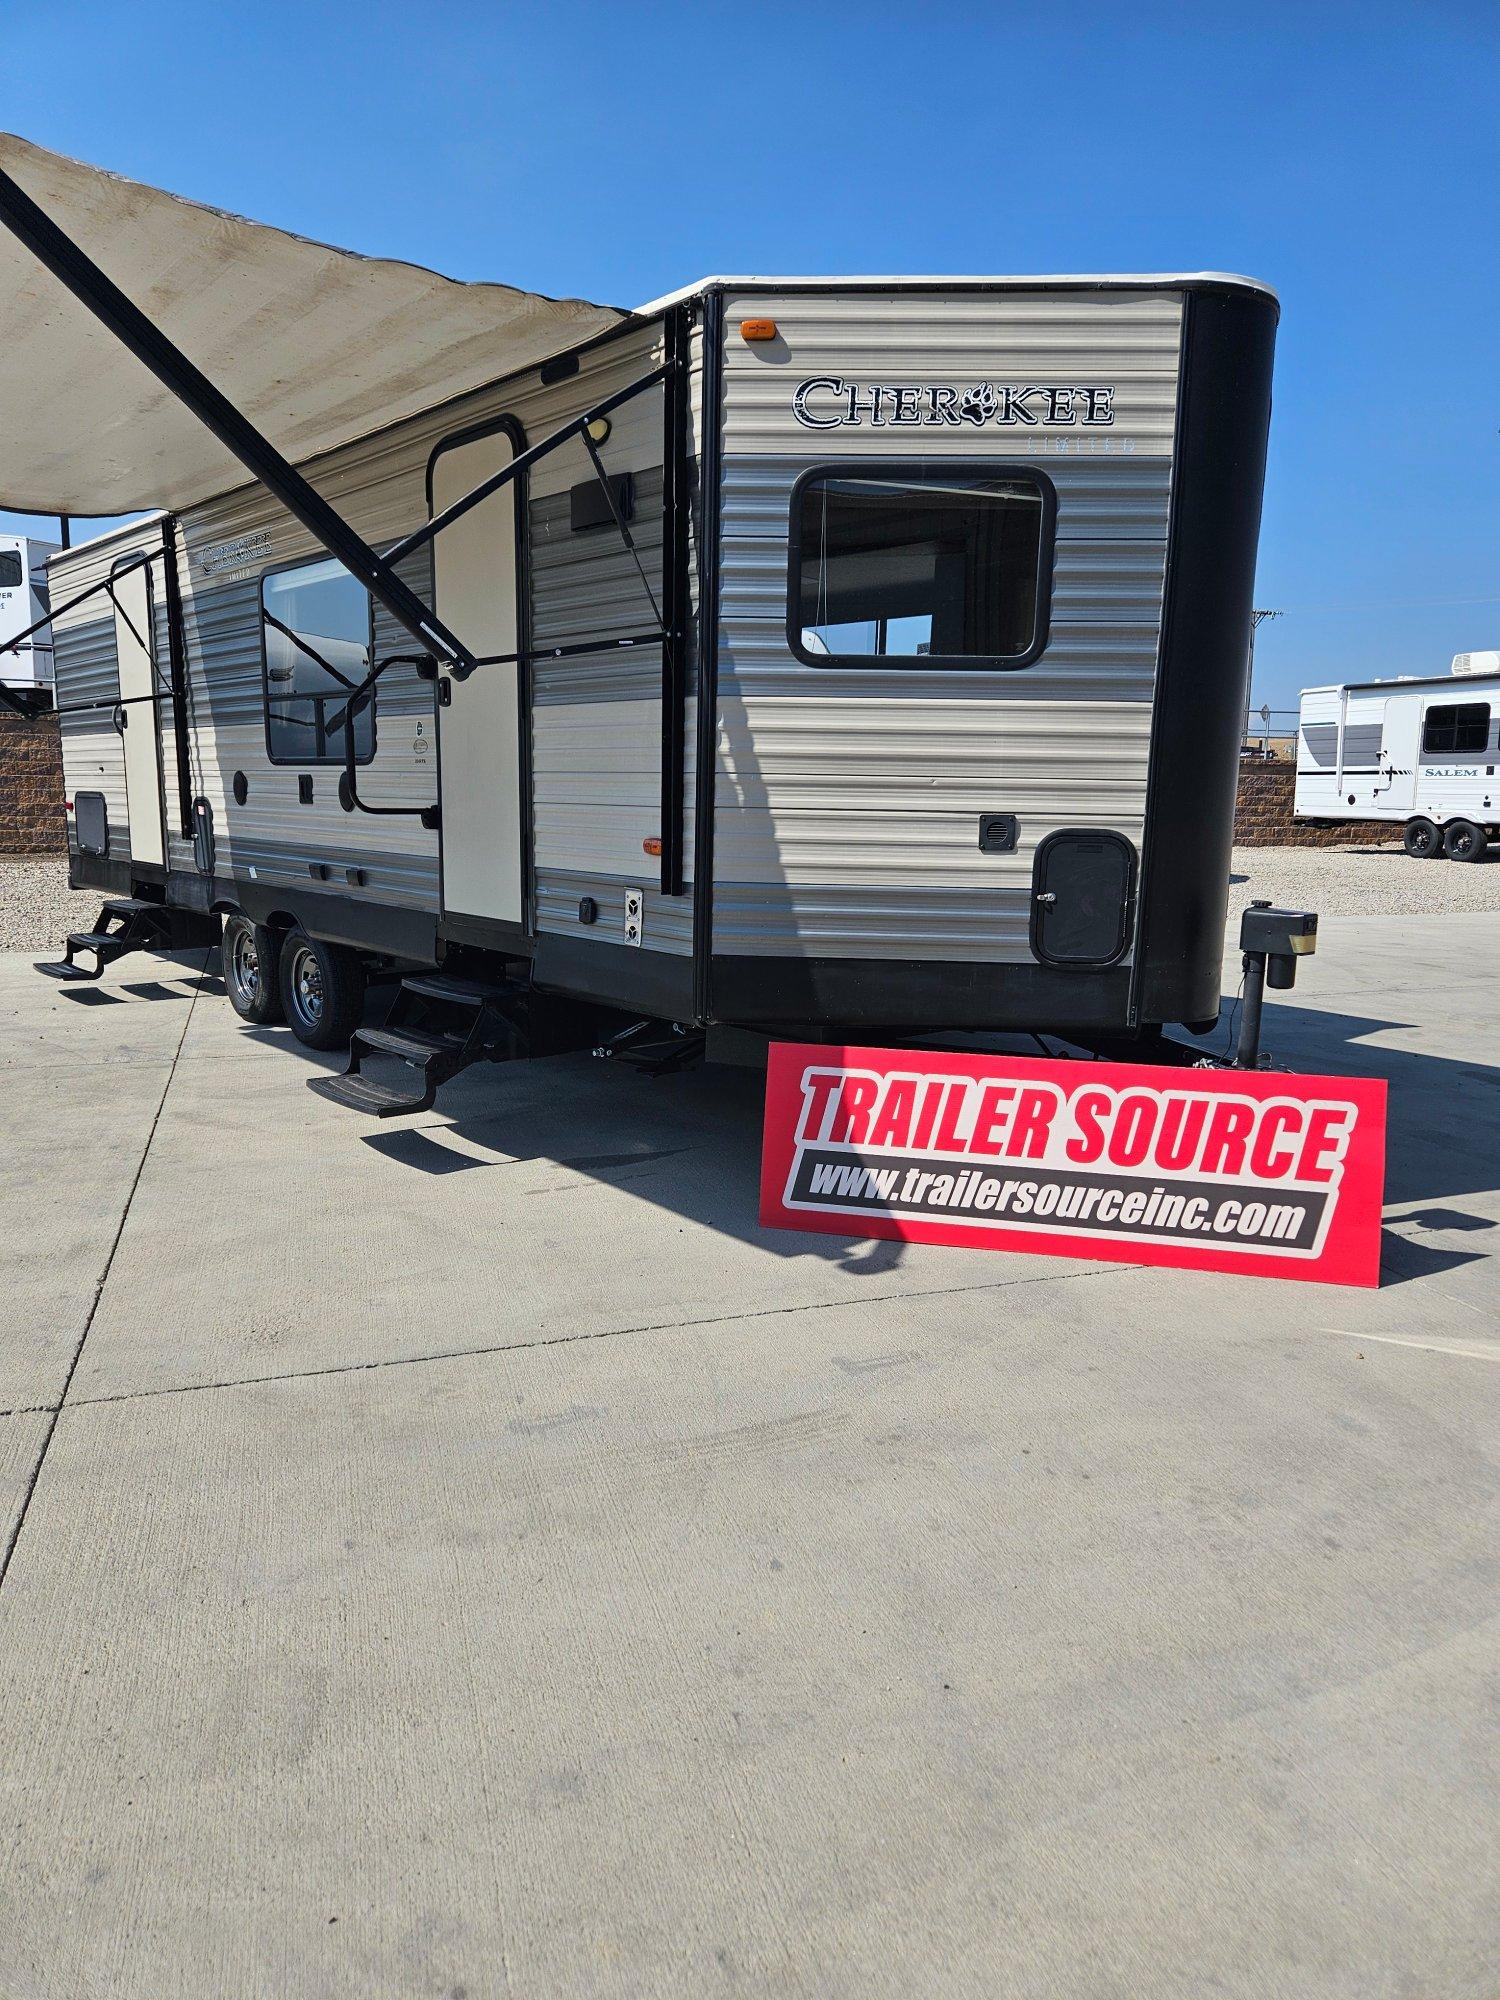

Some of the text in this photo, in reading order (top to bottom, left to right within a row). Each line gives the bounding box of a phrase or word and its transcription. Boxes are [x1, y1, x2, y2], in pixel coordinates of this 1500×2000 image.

[1027, 436, 1136, 454] LIMITED
[1425, 768, 1479, 777] SALEM
[801, 1073, 1349, 1183] TRAILER SOURCE
[808, 1163, 1306, 1240] www.trailersourceinc.com
